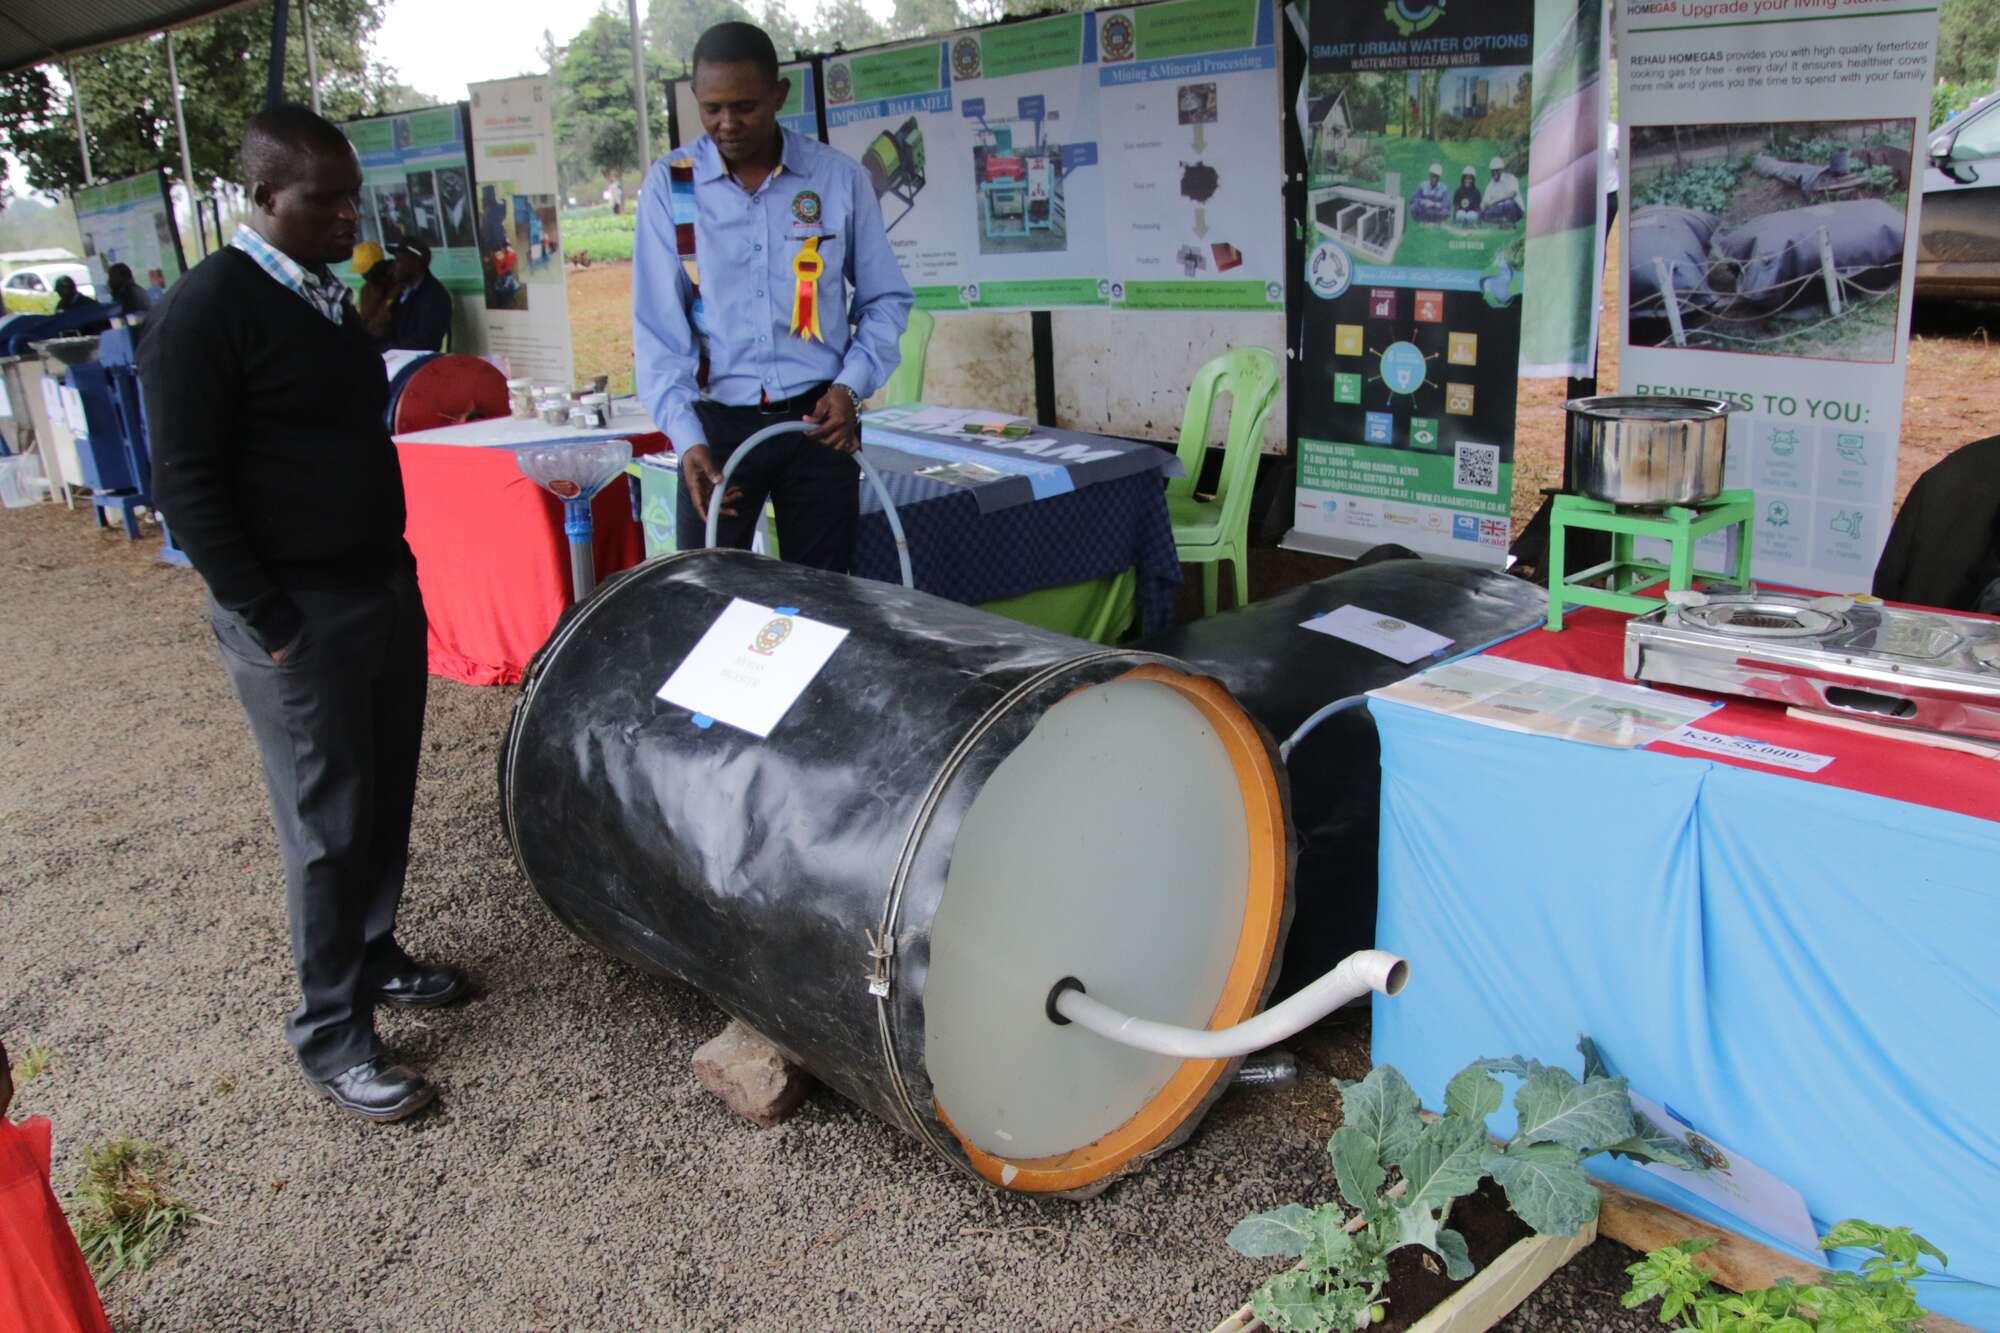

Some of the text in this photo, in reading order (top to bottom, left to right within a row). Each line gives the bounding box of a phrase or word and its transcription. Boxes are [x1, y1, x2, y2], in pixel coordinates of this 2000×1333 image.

[1627, 2, 1677, 15] HOMEGAS
[1681, 1, 1748, 18] Upgrade
[1753, 0, 1789, 14] your
[1312, 34, 1529, 58] SMART URBAN WATER OPTIONS
[1630, 54, 1666, 65] REHAU
[1668, 51, 1724, 63] HOMEGAS
[1726, 49, 1766, 61] provides
[1769, 48, 1788, 60] you
[1791, 46, 1810, 56] with
[1813, 45, 1836, 58] high
[1838, 43, 1874, 56] quality
[1112, 68, 1147, 81] Mining
[1204, 54, 1262, 73] Processing
[1351, 53, 1480, 70] WASTEWATER TO CLEAN WATER
[1630, 68, 1664, 79] cooking
[1668, 69, 1686, 79] gas
[1689, 66, 1702, 75] for
[1705, 65, 1725, 74] free
[1735, 65, 1761, 75] every
[1801, 60, 1842, 71] ensures
[1847, 56, 1893, 68] healthier
[1897, 55, 1927, 66] cows
[1677, 79, 1696, 89] and
[1699, 79, 1724, 90] gives
[1727, 79, 1744, 90] you
[1748, 77, 1763, 87] the
[1791, 74, 1801, 84] to
[1804, 73, 1836, 86] spend
[1839, 71, 1861, 82] with
[1865, 71, 1888, 83] your
[1893, 69, 1926, 81] family
[832, 104, 880, 124] IMPROVE
[888, 99, 916, 116] BALL
[1763, 395, 1797, 416] TO
[1805, 399, 1870, 424] YOU:
